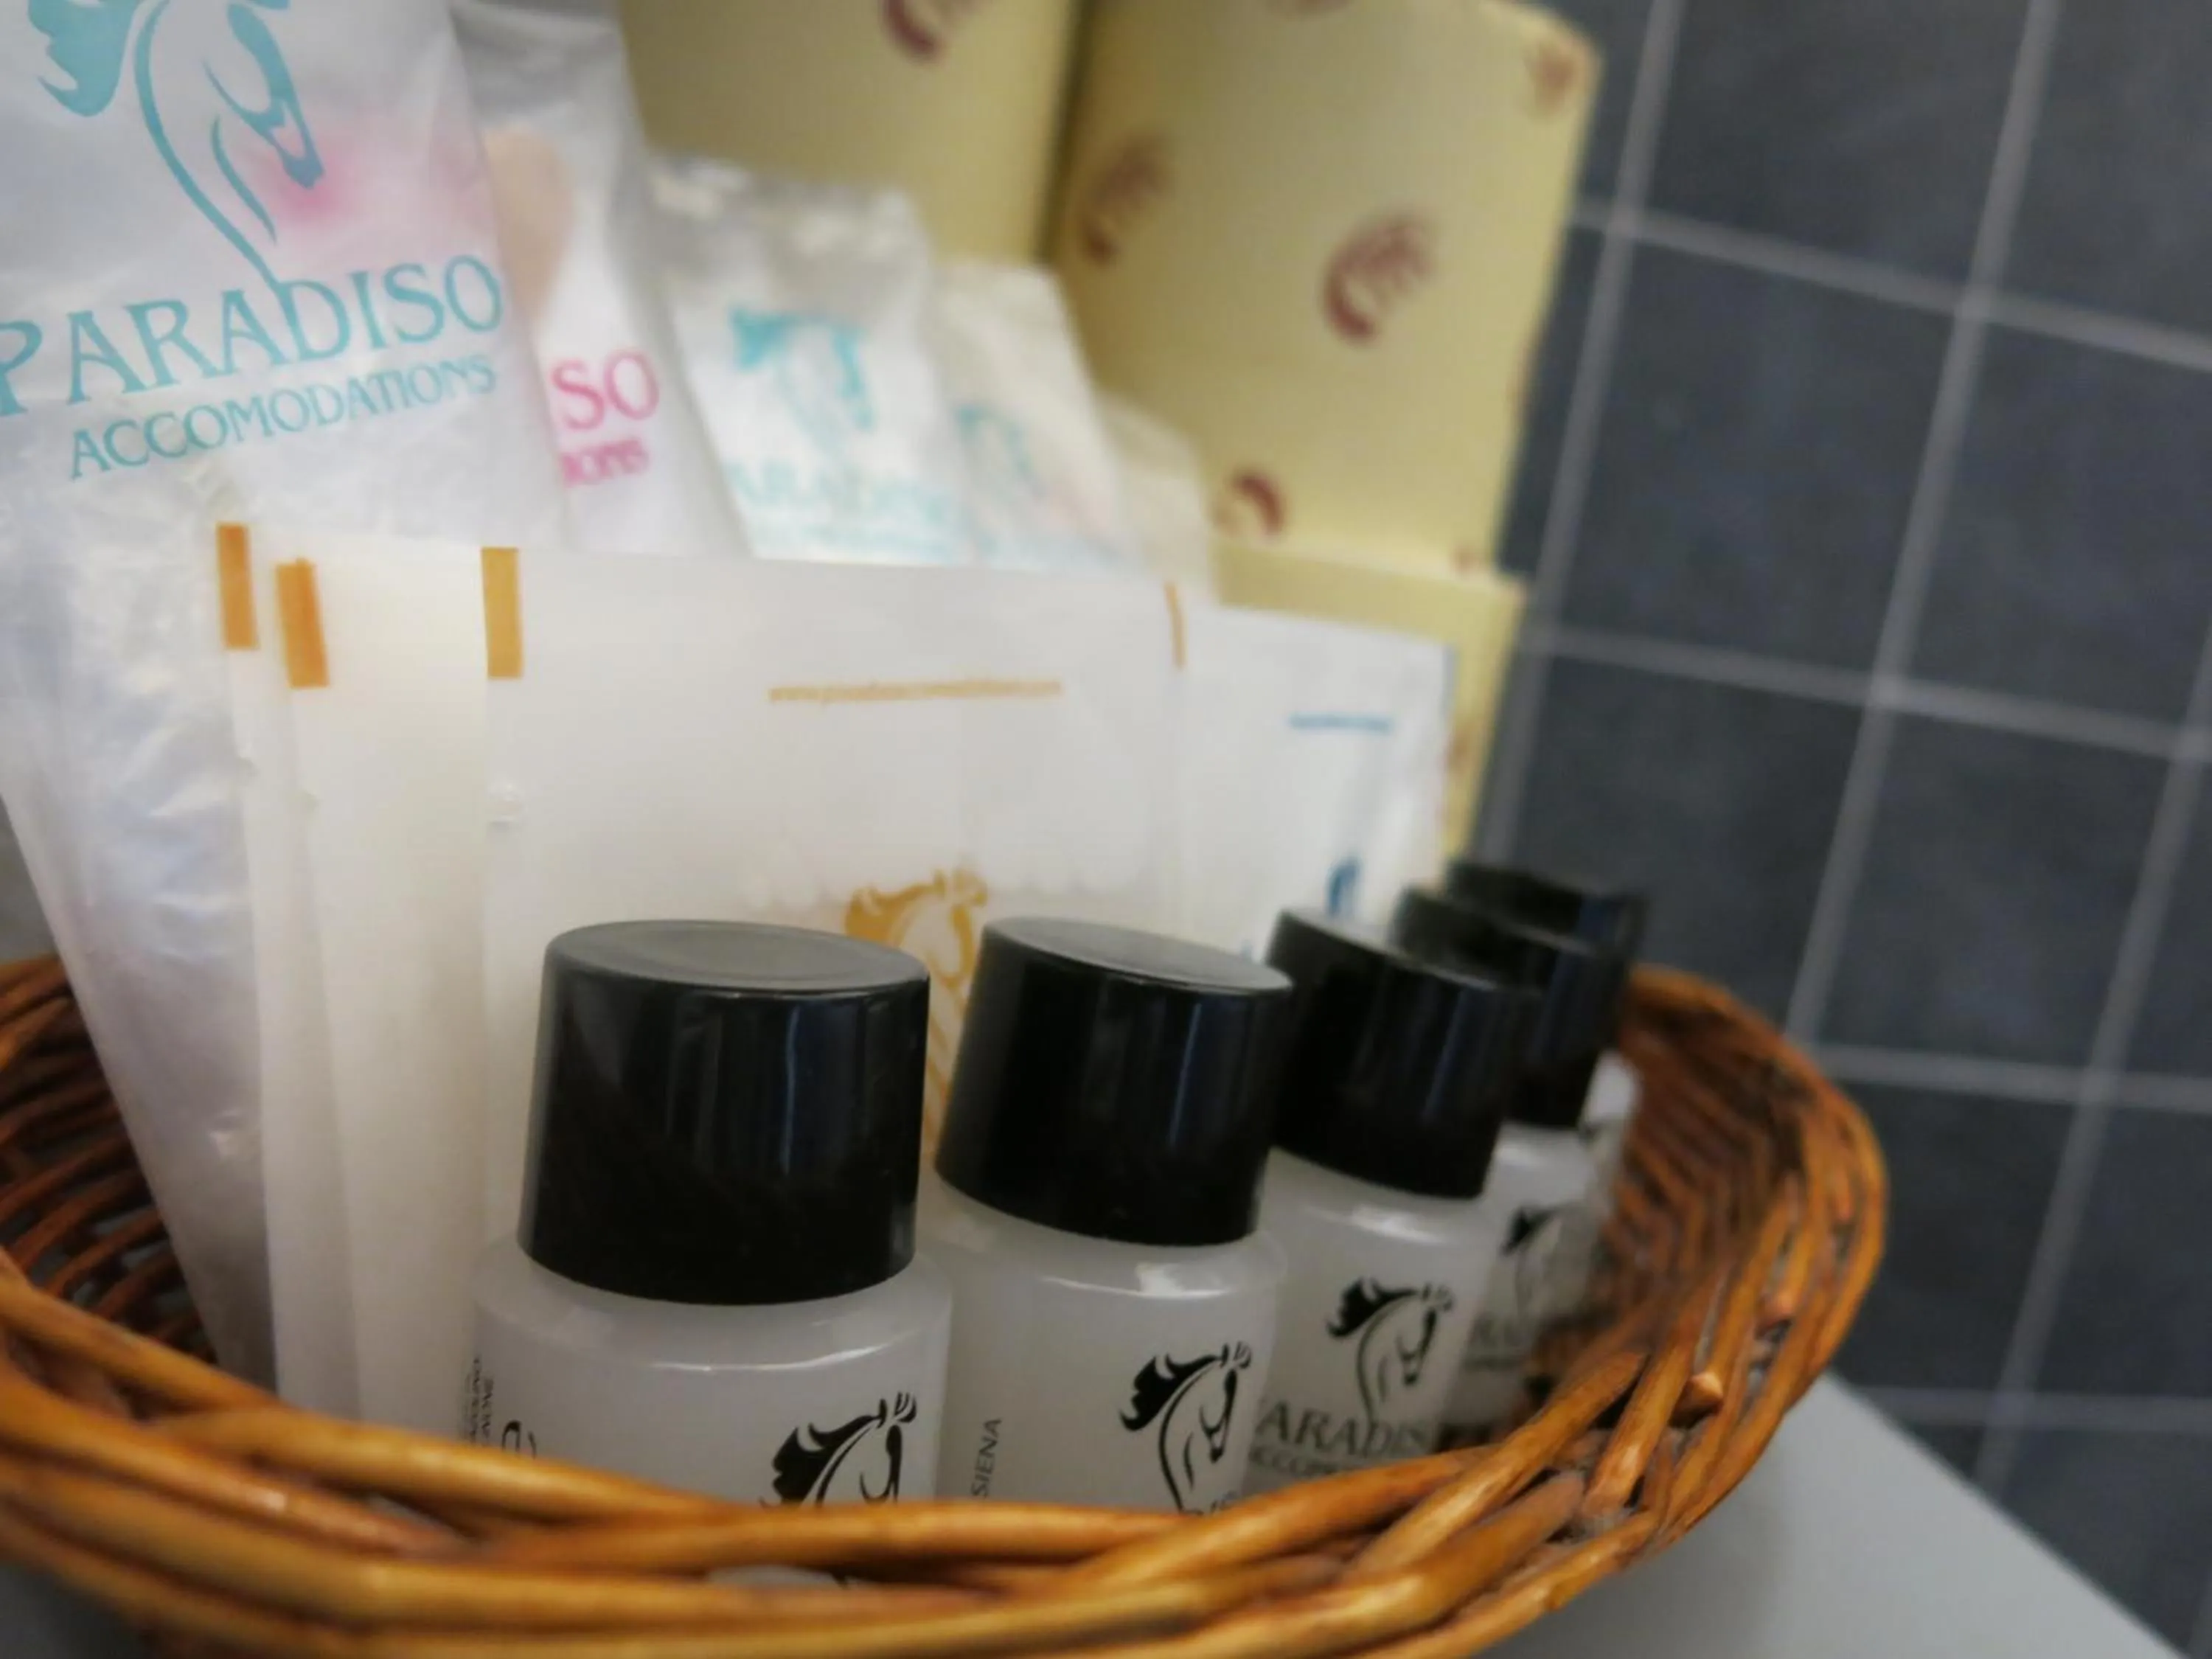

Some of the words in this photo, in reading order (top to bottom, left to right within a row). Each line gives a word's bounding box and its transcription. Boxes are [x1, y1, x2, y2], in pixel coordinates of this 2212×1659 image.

[0, 254, 504, 416] PARADISO
[69, 352, 497, 481] ACCOMODATIONS
[970, 1417, 1003, 1500] SIENA
